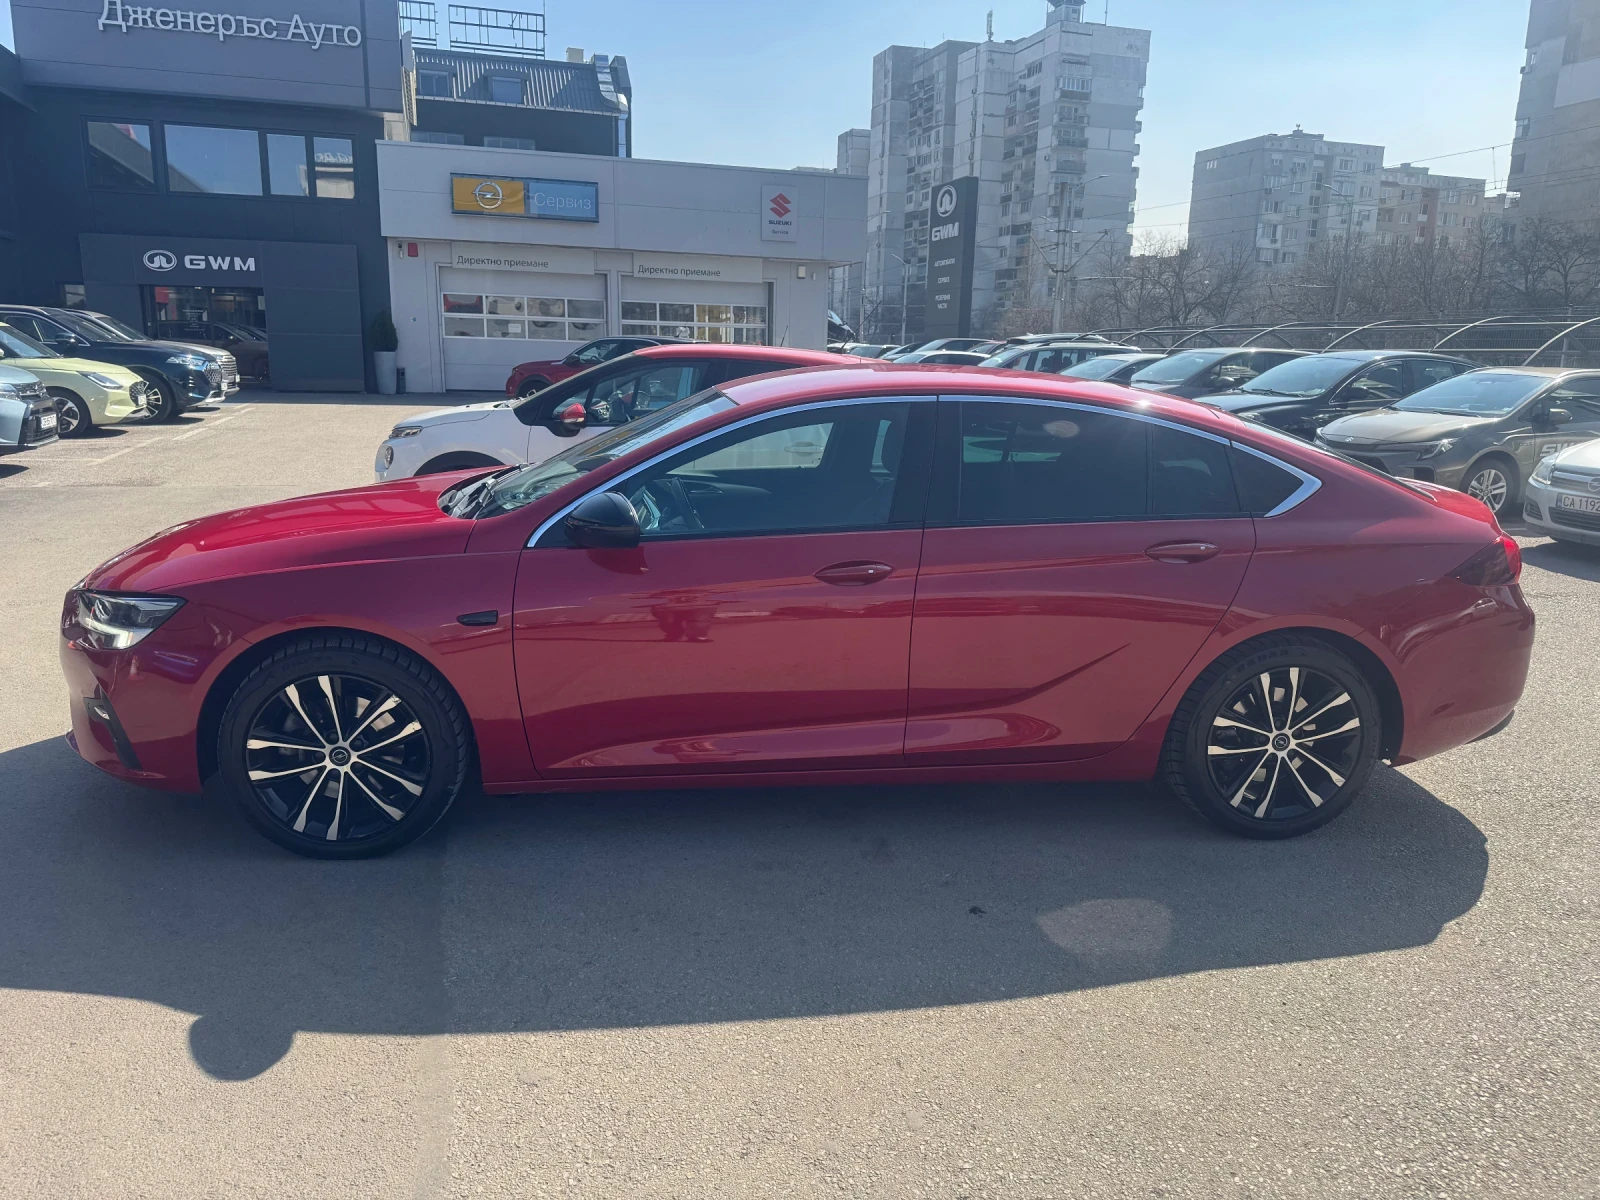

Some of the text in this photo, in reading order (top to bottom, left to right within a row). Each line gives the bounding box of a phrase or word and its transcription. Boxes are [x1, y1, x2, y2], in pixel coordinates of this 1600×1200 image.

[98, 0, 362, 49] Дженеръс Ауто
[534, 192, 592, 210] Сервиз
[932, 222, 959, 241] GWM
[184, 254, 256, 272] GWM
[456, 255, 549, 268] Директно приемане
[637, 264, 721, 277] Директно приемане
